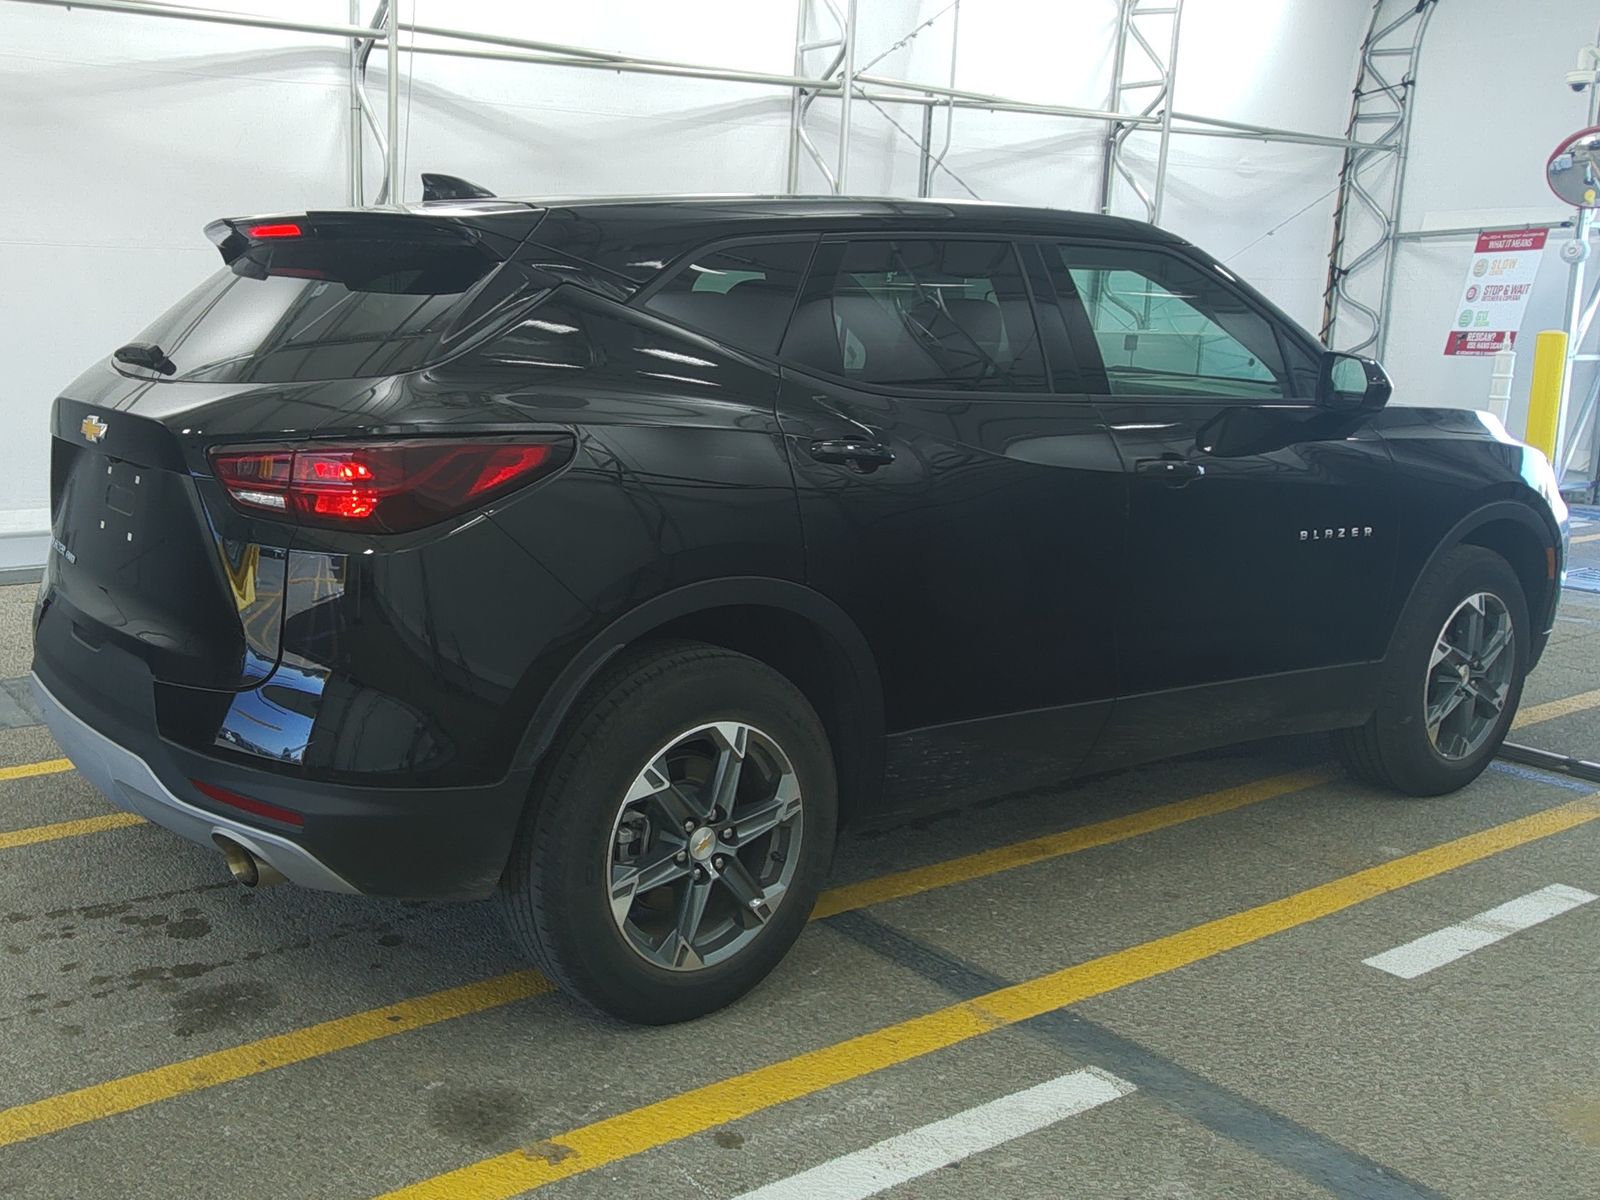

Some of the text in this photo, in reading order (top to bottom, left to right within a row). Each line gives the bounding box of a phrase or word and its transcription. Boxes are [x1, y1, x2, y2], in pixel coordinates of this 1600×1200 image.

[1483, 284, 1504, 296] STOP
[1510, 283, 1531, 295] WAIT
[1299, 526, 1373, 541] BLAZER
